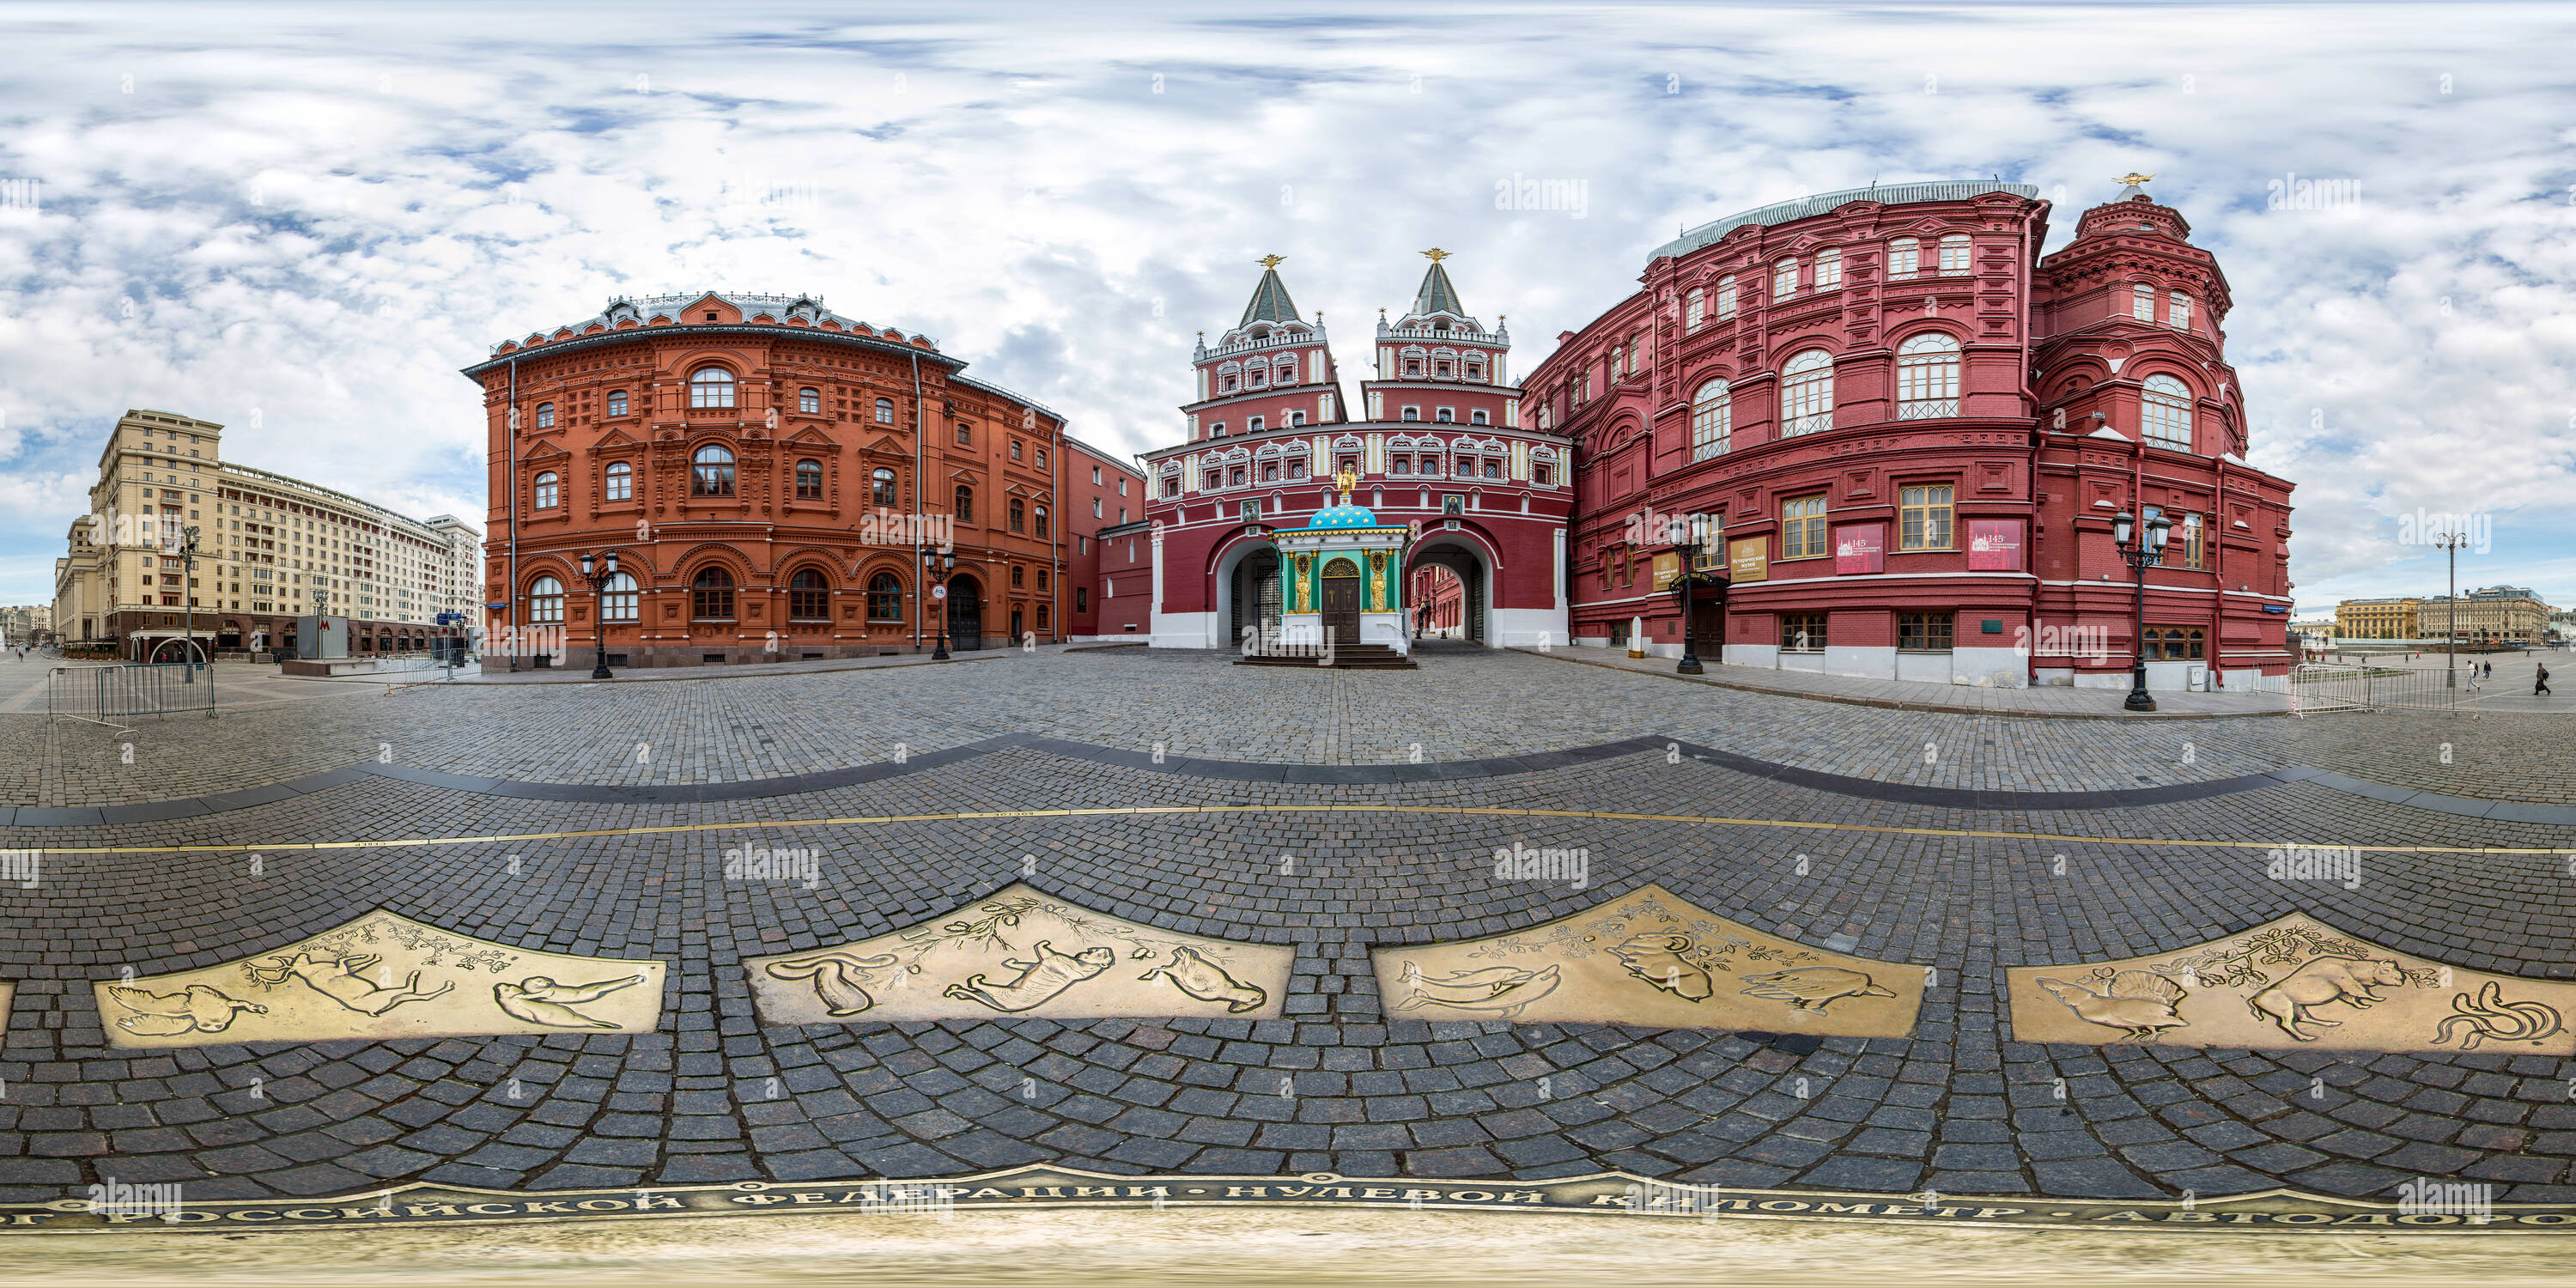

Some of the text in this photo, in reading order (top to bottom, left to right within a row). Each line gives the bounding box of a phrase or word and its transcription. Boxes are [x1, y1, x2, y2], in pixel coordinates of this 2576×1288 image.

[1989, 534, 2004, 543] 145
[1732, 555, 1765, 564] Исторический
[103, 1195, 686, 1224] РОССИЙСКОЙ
[732, 1186, 1172, 1206] ФЕДЕРАЦИИ
[1224, 1186, 1546, 1204] НУЛЕВОЙ
[1589, 1194, 2026, 1218] КИЛОМЕТР
